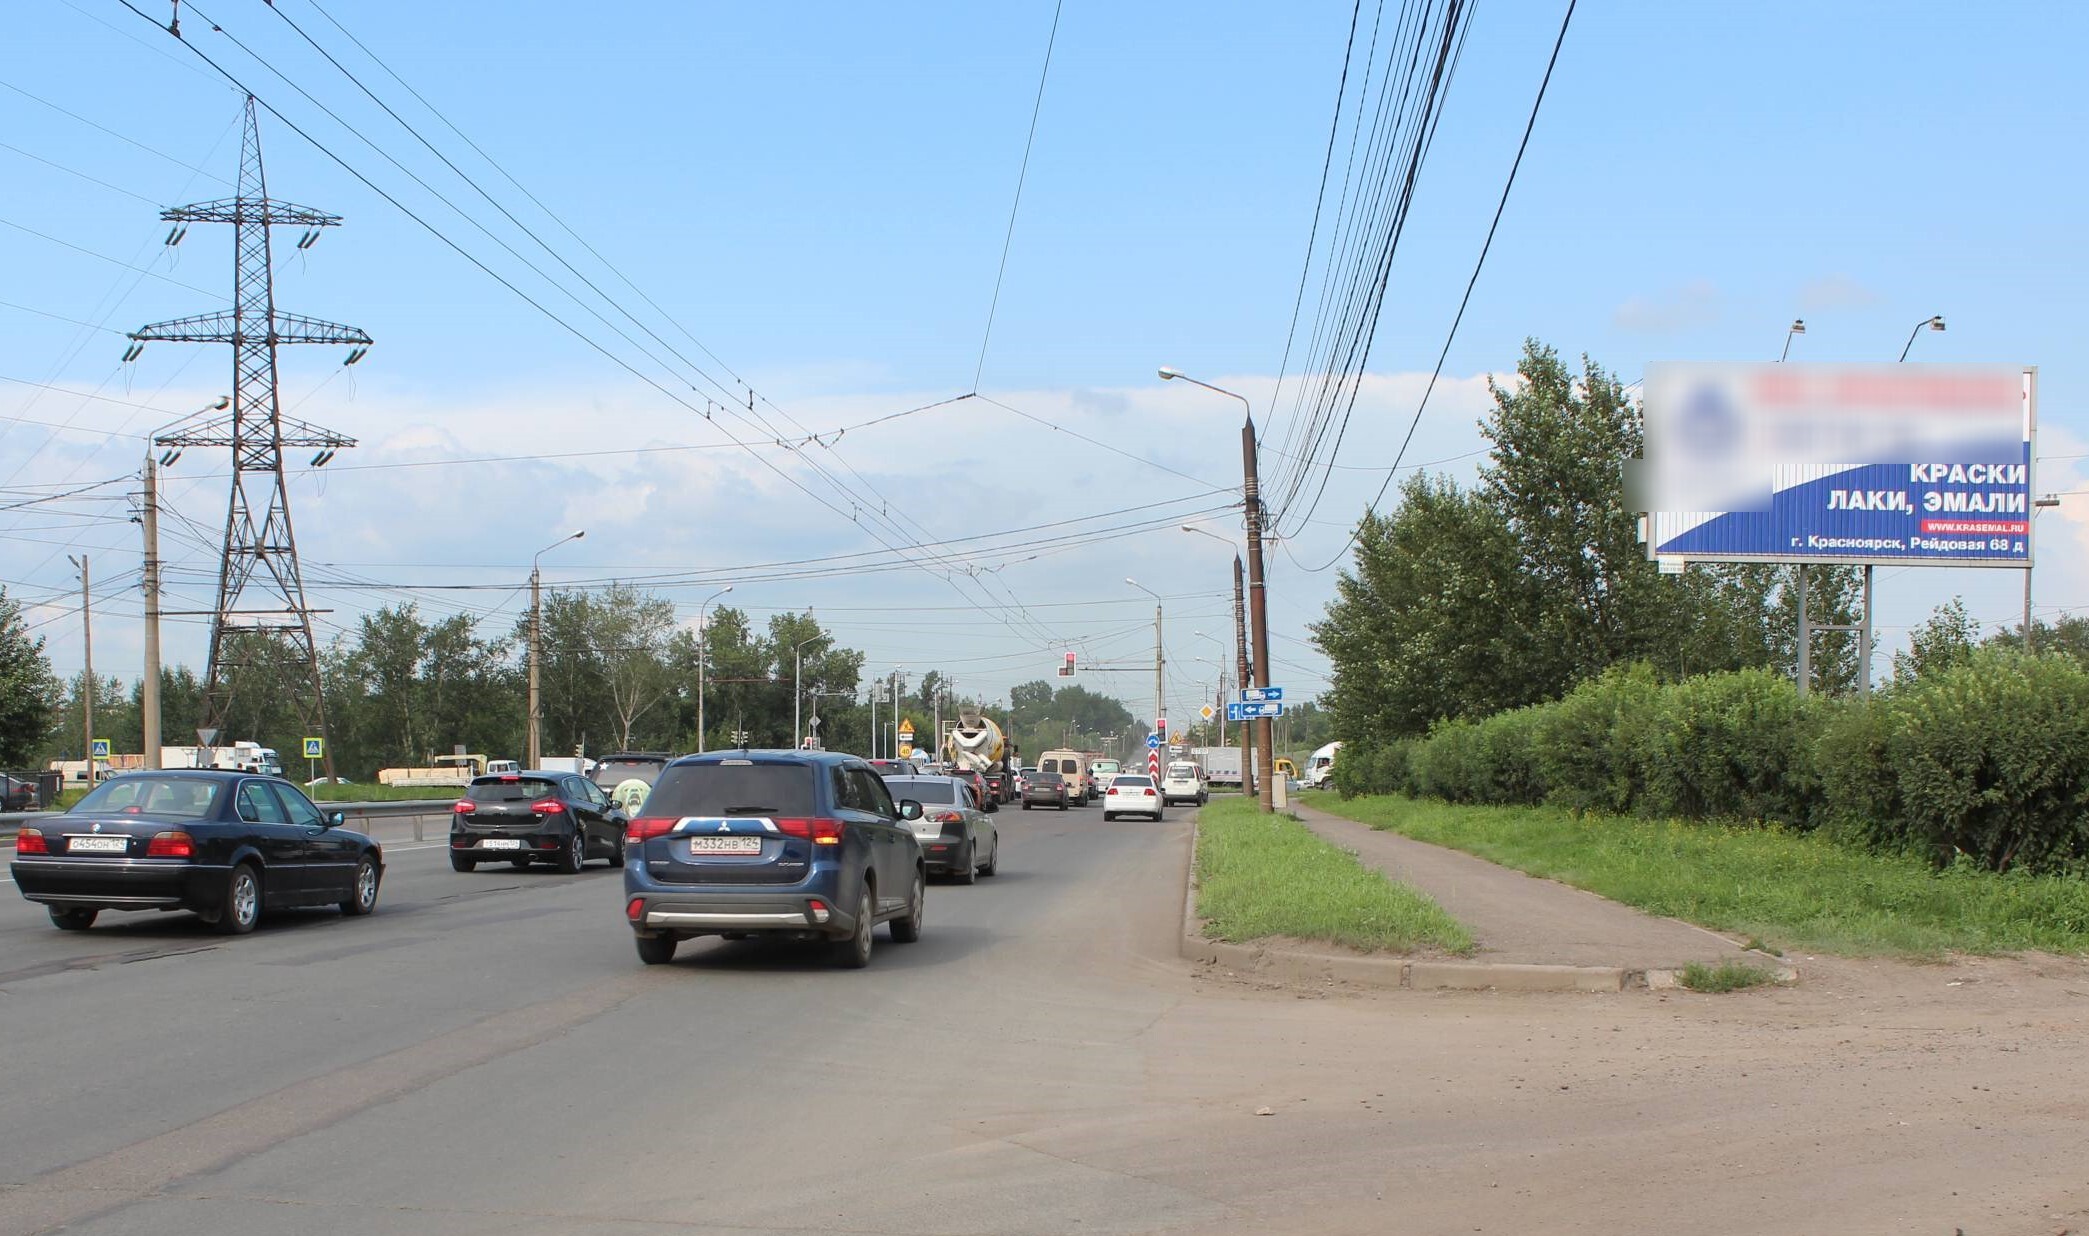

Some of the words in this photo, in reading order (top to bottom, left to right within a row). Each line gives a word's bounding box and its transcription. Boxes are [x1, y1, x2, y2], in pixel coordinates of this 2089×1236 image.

[1910, 463, 2026, 484] КРАСКИ
[1826, 490, 1913, 515] ЛАКИ,
[1923, 491, 2026, 513] ЭМАЛИ
[1927, 522, 2025, 533] WWW.KRASEMAL.RU
[1790, 537, 1802, 548] г.
[1808, 535, 1905, 551] Красноярск,
[1910, 536, 1985, 551] Рейдовая
[1989, 538, 2008, 551] 68
[2012, 541, 2024, 553] д
[741, 838, 759, 847] 124
